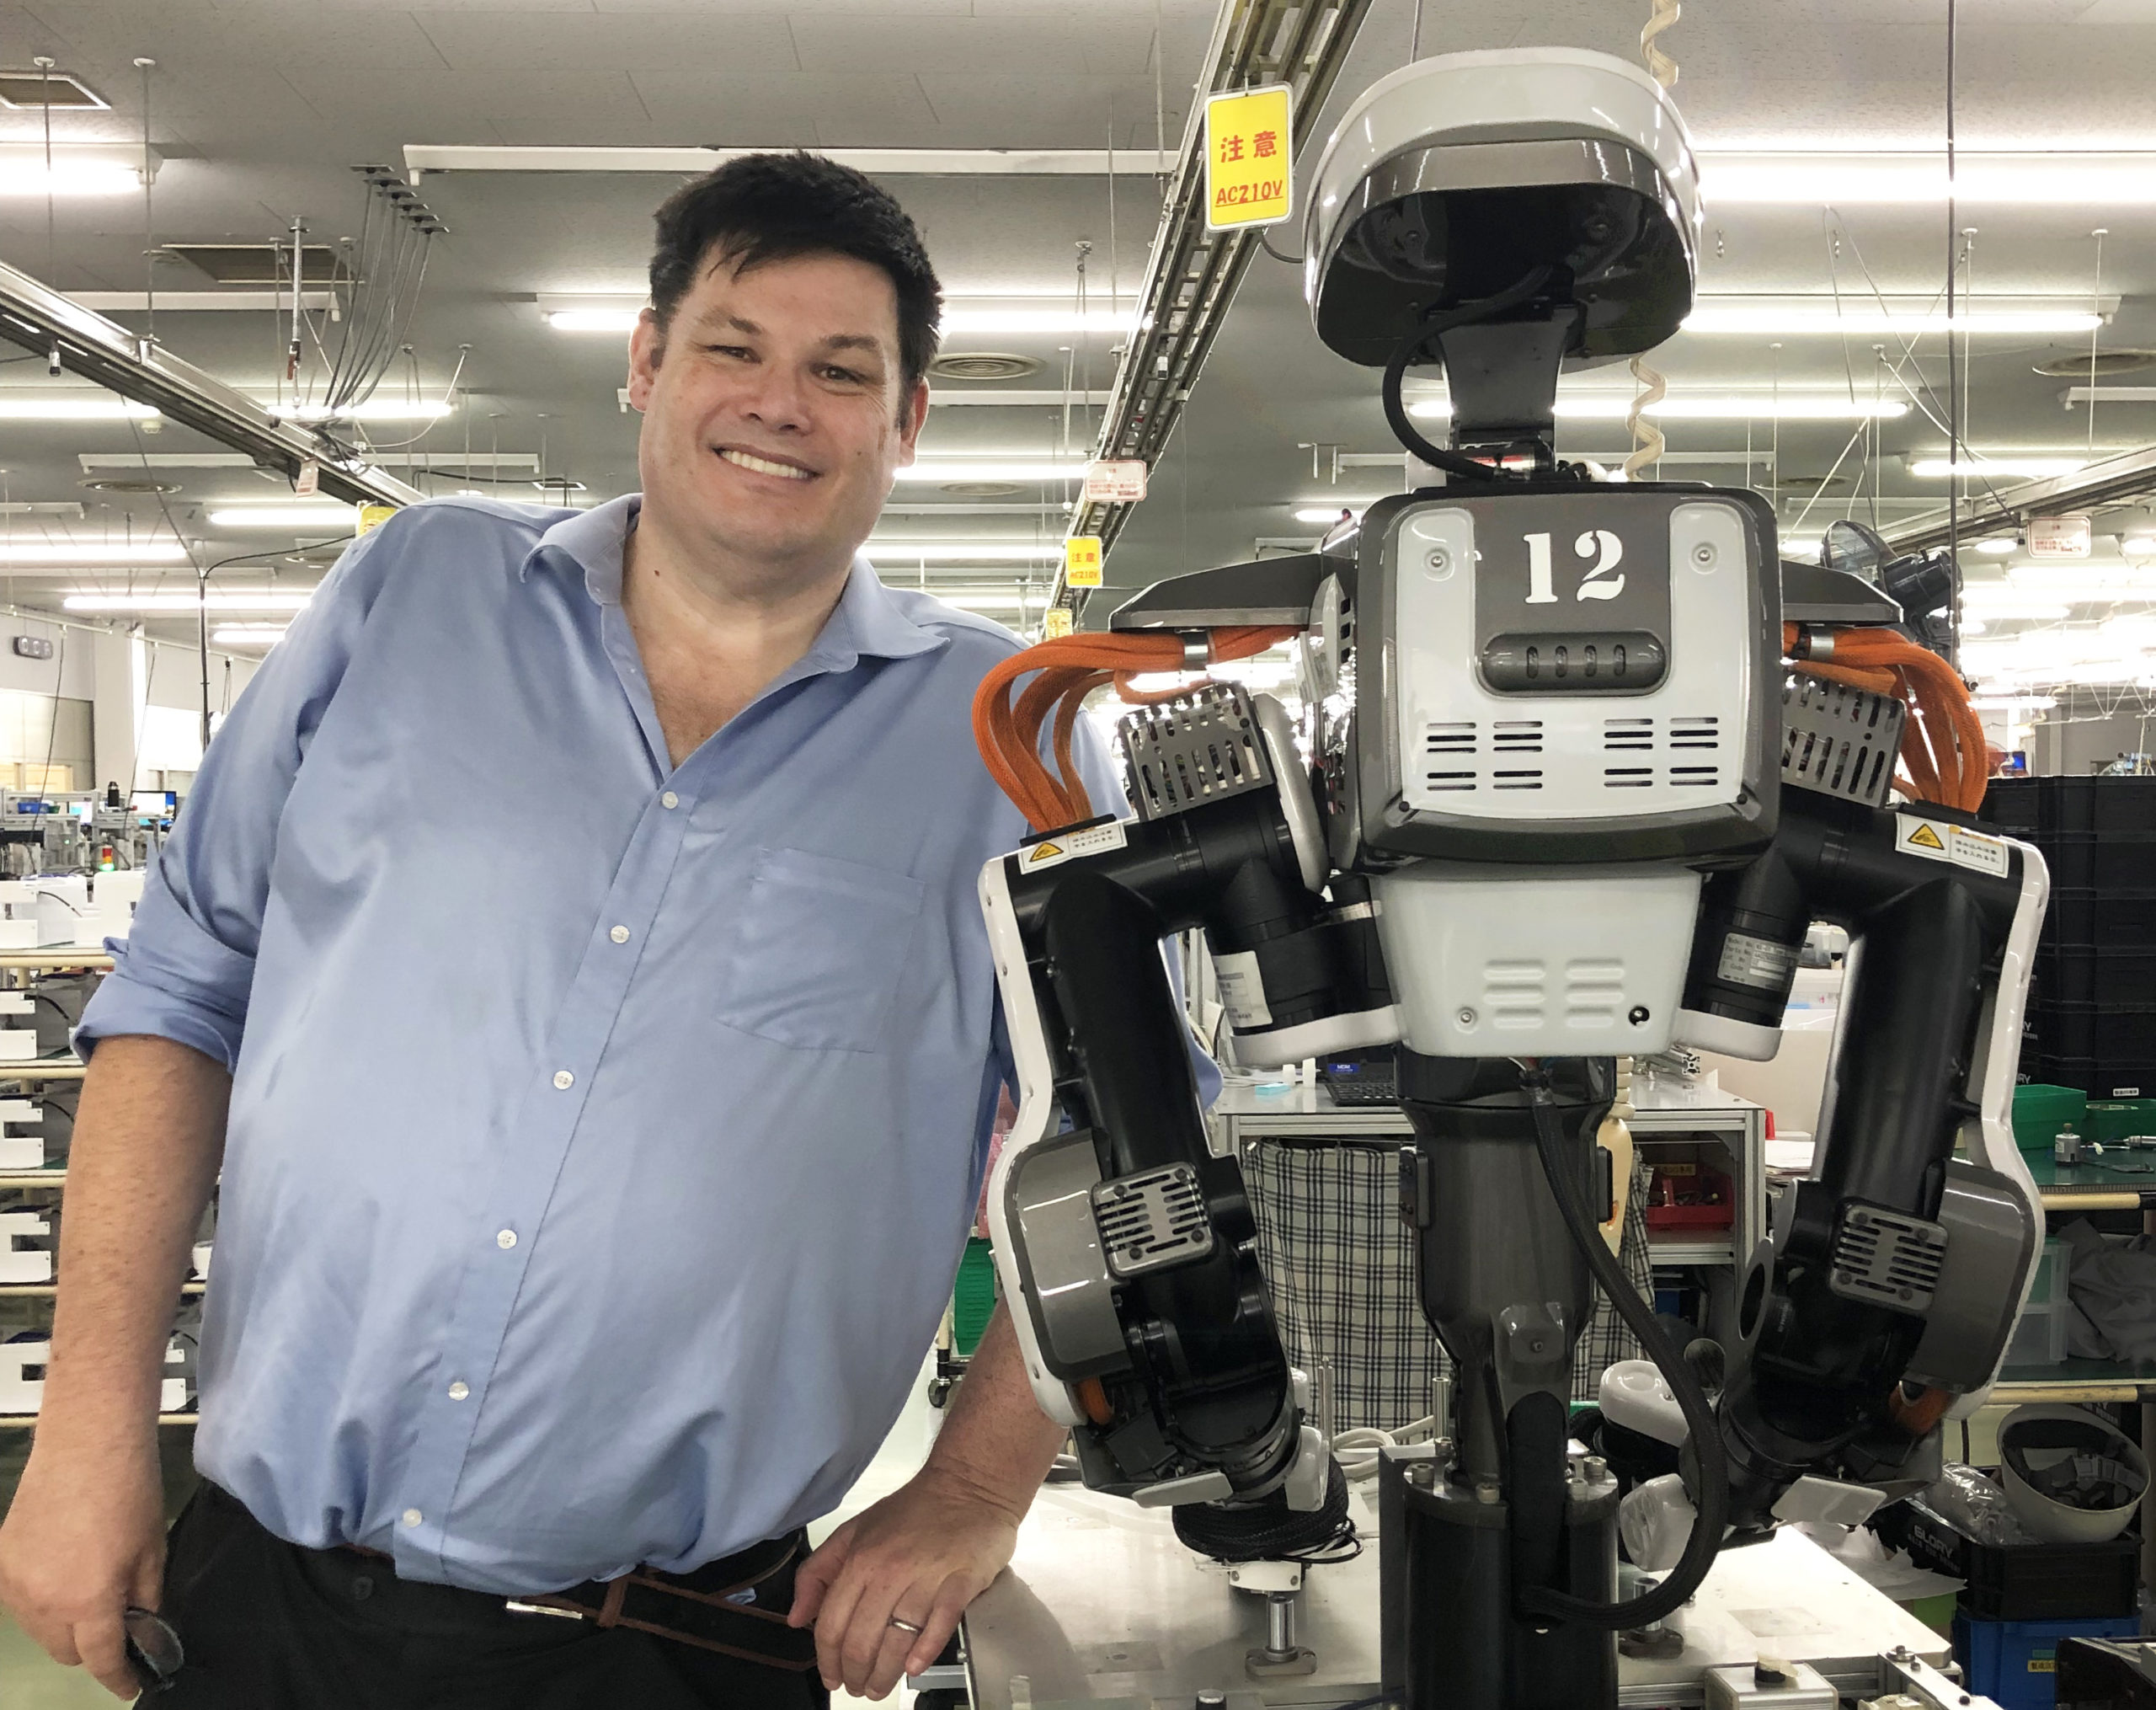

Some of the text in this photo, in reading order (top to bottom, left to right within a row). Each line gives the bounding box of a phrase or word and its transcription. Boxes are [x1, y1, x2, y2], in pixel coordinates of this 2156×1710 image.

[1220, 131, 1277, 163] 注意
[1216, 179, 1283, 206] AC210V
[1071, 552, 1095, 563] 注意
[1524, 530, 1625, 603] 12
